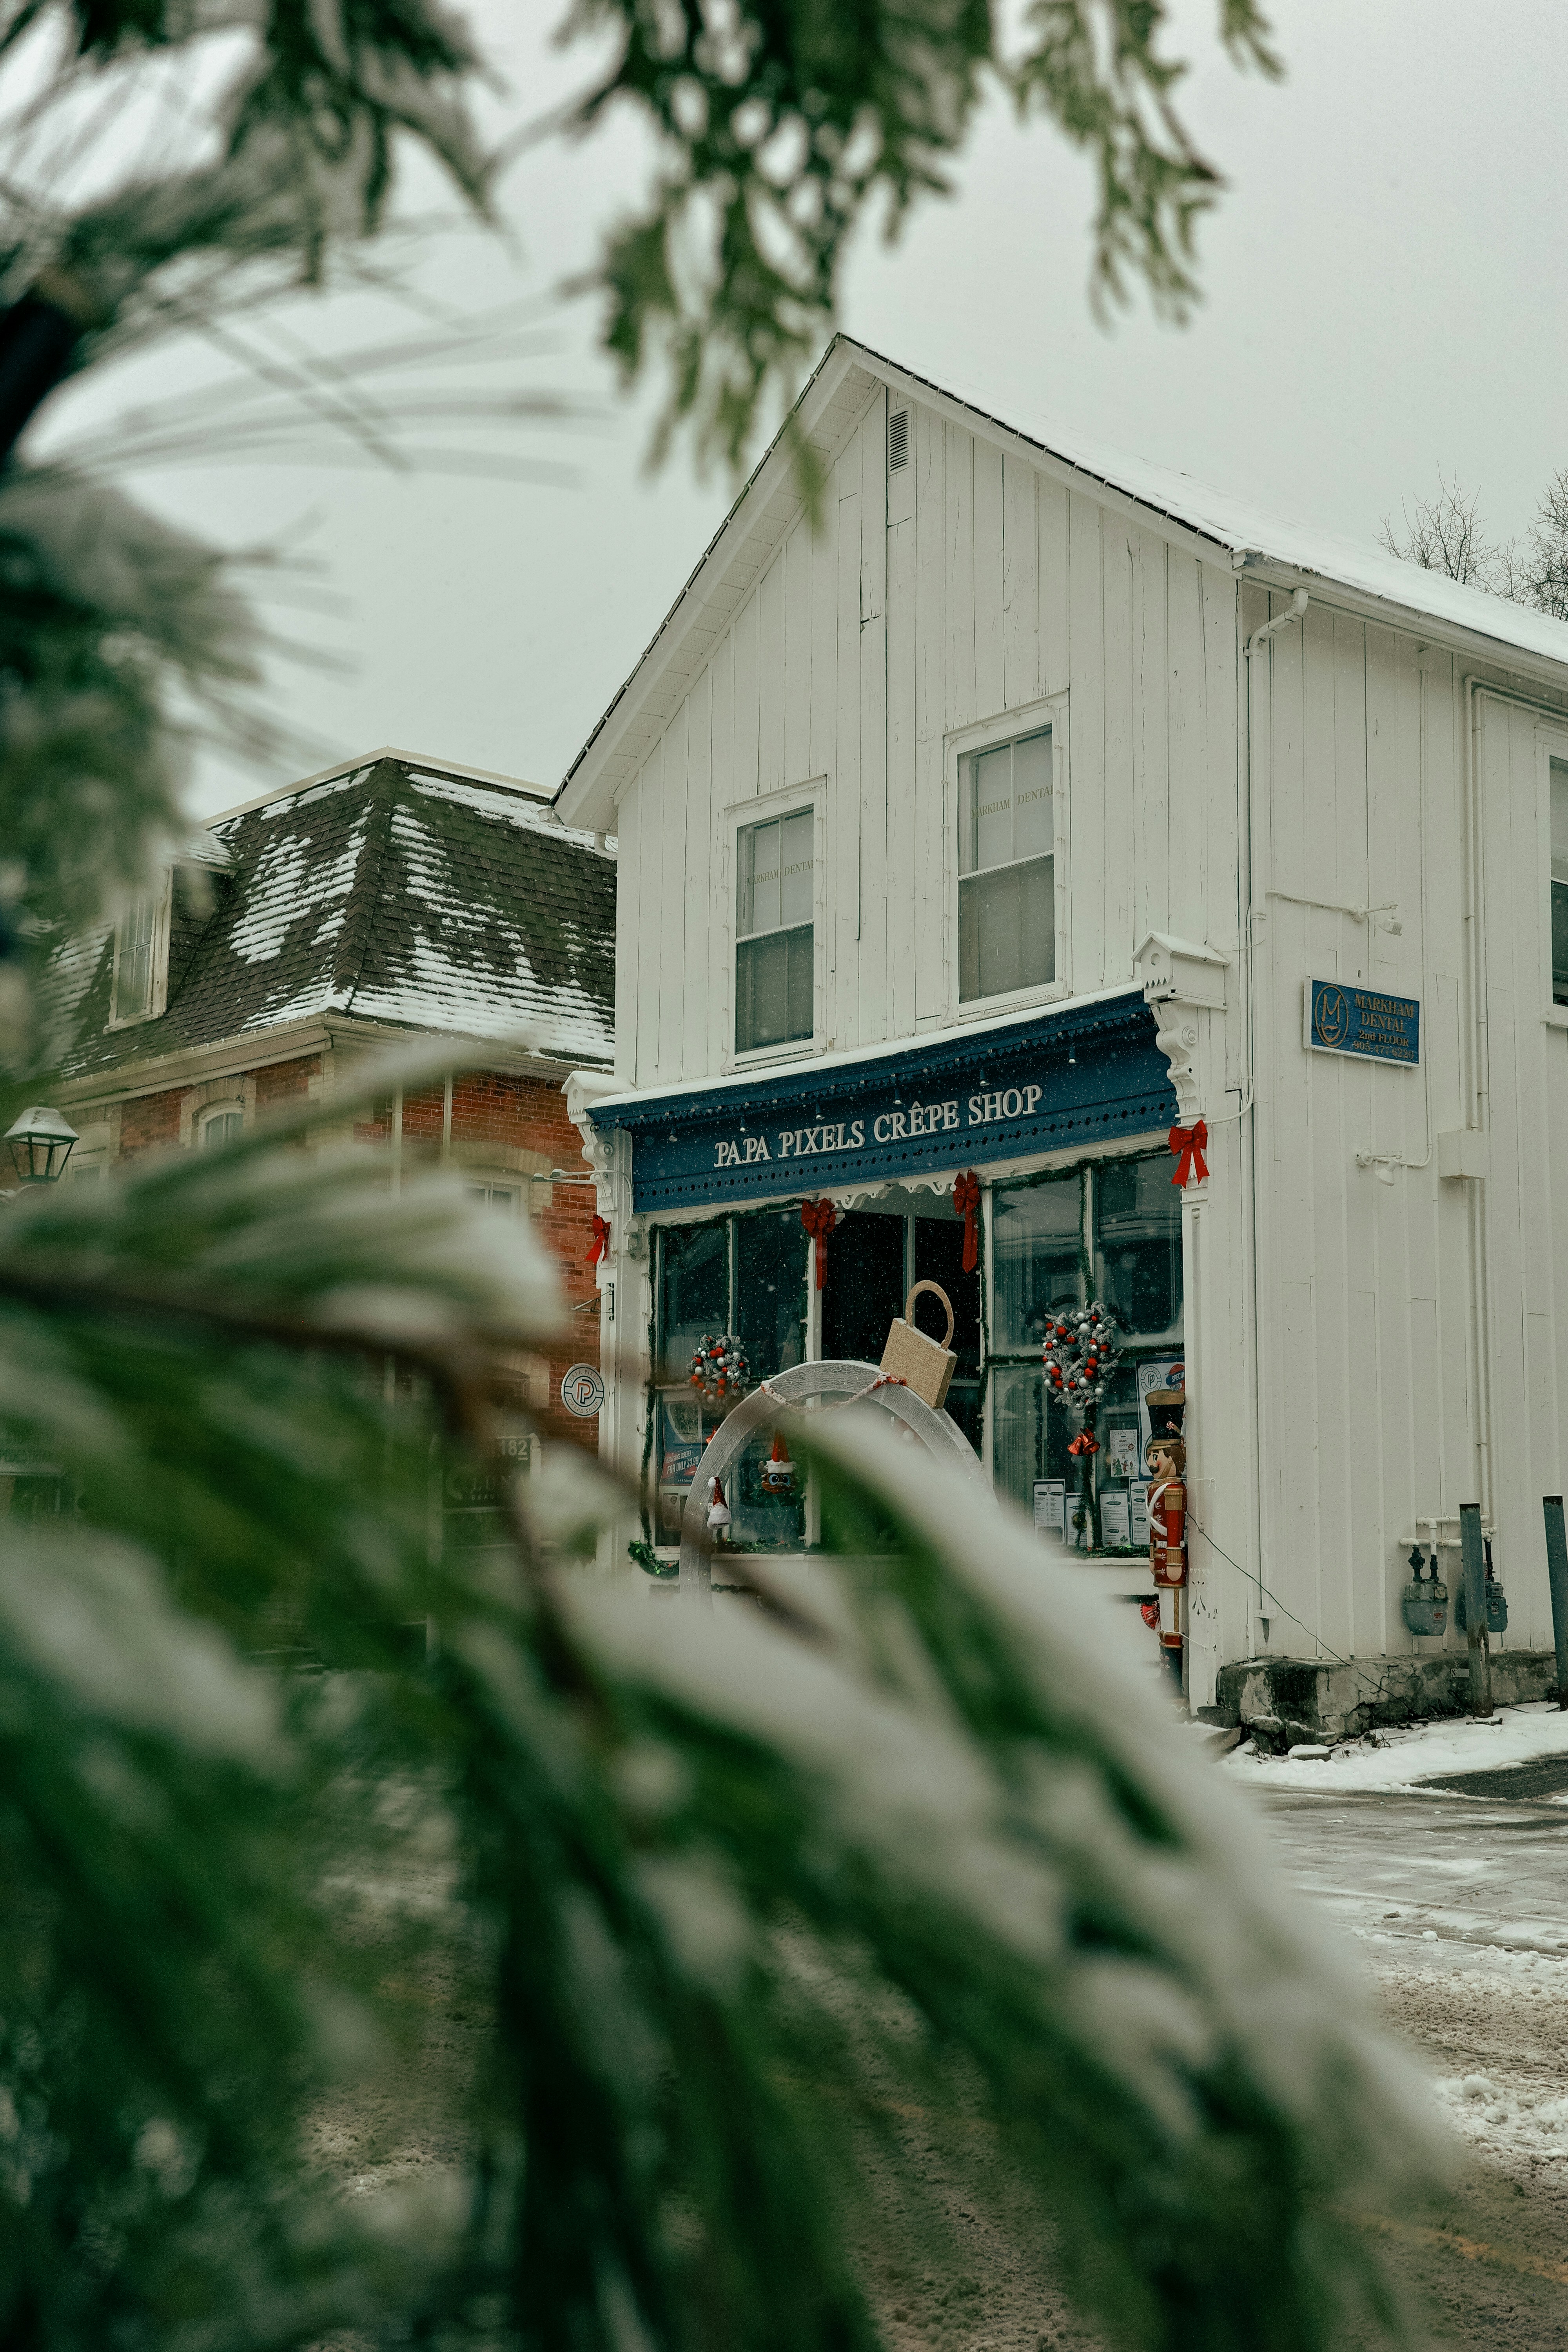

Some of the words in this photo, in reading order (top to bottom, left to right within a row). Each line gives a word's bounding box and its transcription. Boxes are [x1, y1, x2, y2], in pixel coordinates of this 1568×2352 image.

[971, 799, 1011, 819] MARKHAM
[746, 869, 779, 887] MARKHAM
[1355, 994, 1414, 1018] MARKHAM
[1361, 1012, 1406, 1034] DENTAL
[1358, 1029, 1376, 1041] 2nd
[1378, 1033, 1409, 1047] FLOOR
[714, 1135, 772, 1168] PAPA
[778, 1120, 865, 1158] PIXELS
[873, 1101, 960, 1142] CRÊPE
[968, 1085, 1043, 1125] SHOP
[569, 1370, 582, 1382] PAPA
[584, 1369, 601, 1385] PIXELS
[1171, 1371, 1185, 1383] SPECIA
[568, 1399, 584, 1414] CREPE
[585, 1402, 599, 1414] SHOP
[667, 1464, 675, 1474] FOR
[676, 1460, 686, 1472] ONLY
[687, 1455, 699, 1468] $3.99
